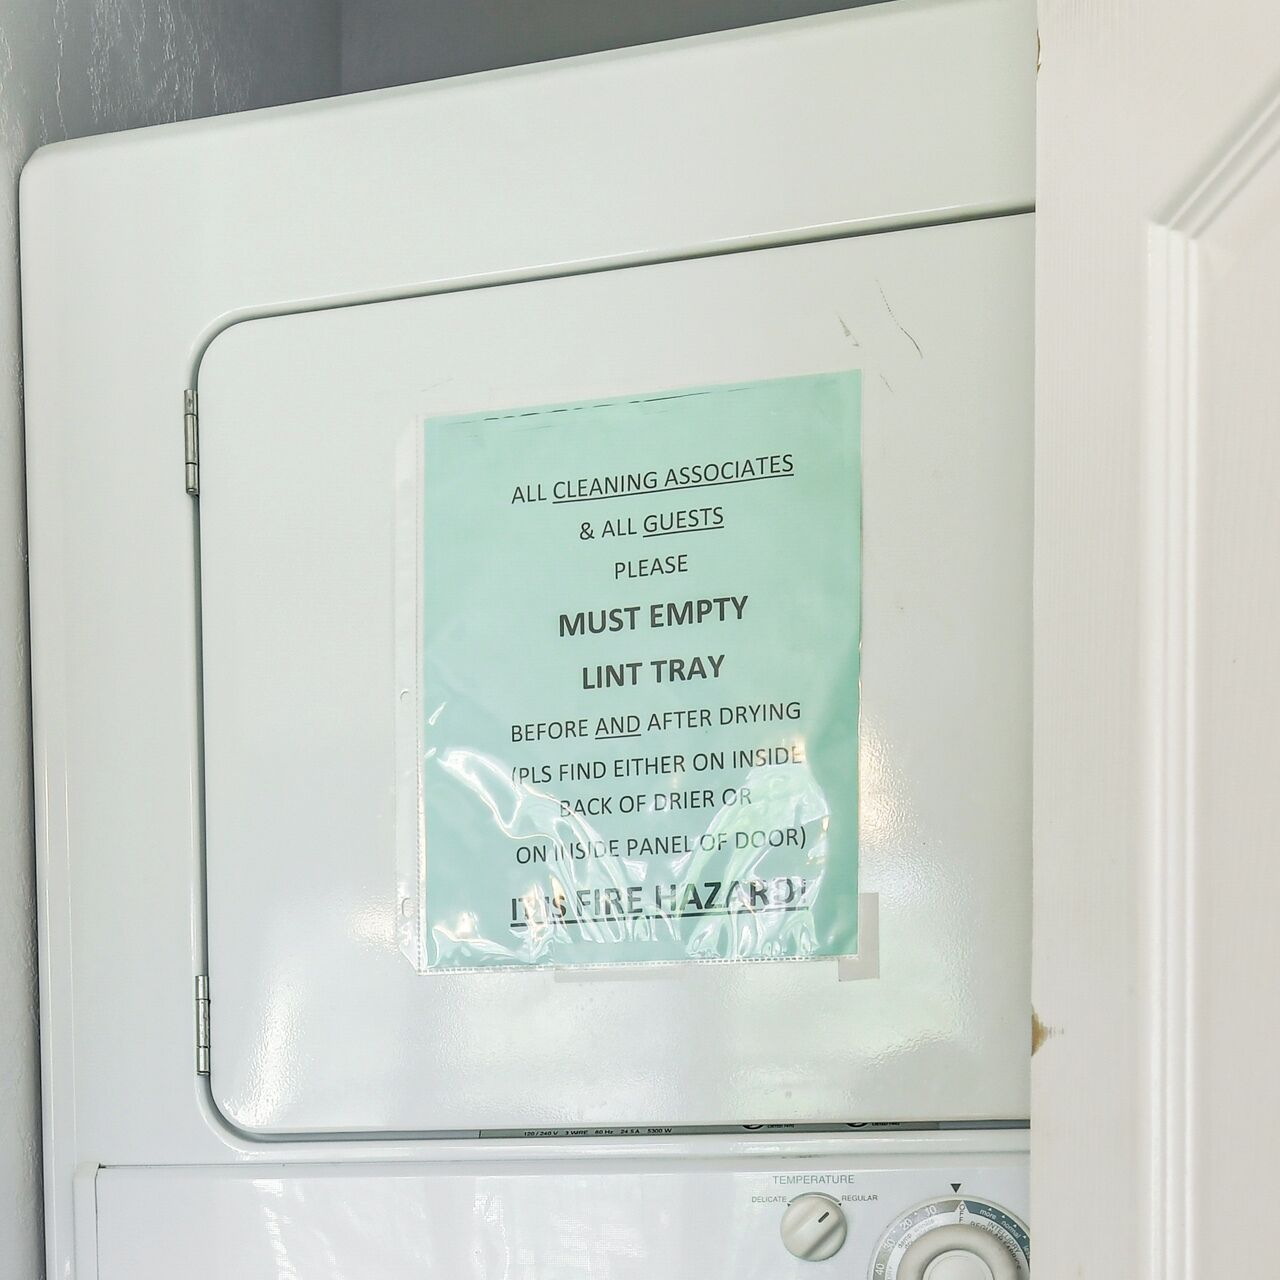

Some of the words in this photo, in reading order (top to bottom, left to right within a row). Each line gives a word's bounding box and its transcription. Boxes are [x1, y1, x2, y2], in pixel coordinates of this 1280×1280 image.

[512, 483, 547, 504] ALL
[552, 471, 658, 502] CLEANING
[665, 454, 794, 490] ASSOCIATES
[579, 522, 595, 541] &
[601, 518, 637, 538] ALL
[643, 507, 724, 537] GUESTS
[615, 554, 689, 580] PLEASE
[559, 606, 641, 637] MUST
[650, 595, 748, 628] EMPTY
[582, 662, 643, 689] LINT
[650, 654, 725, 683] TRAY
[511, 719, 589, 742] BEFORE
[595, 715, 641, 739] AND
[647, 709, 712, 731] AFTER
[719, 702, 801, 726] DRYING
[511, 765, 552, 788] (PLS
[559, 761, 607, 782] FIND
[614, 755, 685, 778] EITHER
[693, 752, 725, 771] ON
[733, 746, 802, 769] INSIDE
[559, 796, 612, 817] BACK
[619, 794, 646, 813] OF
[654, 791, 715, 811] DRIER
[722, 788, 752, 806] OR
[516, 845, 547, 864] ON
[553, 840, 620, 862] INSIDE
[627, 835, 693, 856] PANEL
[700, 832, 728, 852] OF
[735, 826, 807, 849] DOOR)
[577, 886, 643, 917] FIRE
[772, 1174, 855, 1185] TEMPERATURE
[841, 1194, 878, 1202] REGULAR
[900, 1218, 913, 1231] 20
[874, 1263, 885, 1275] 40
